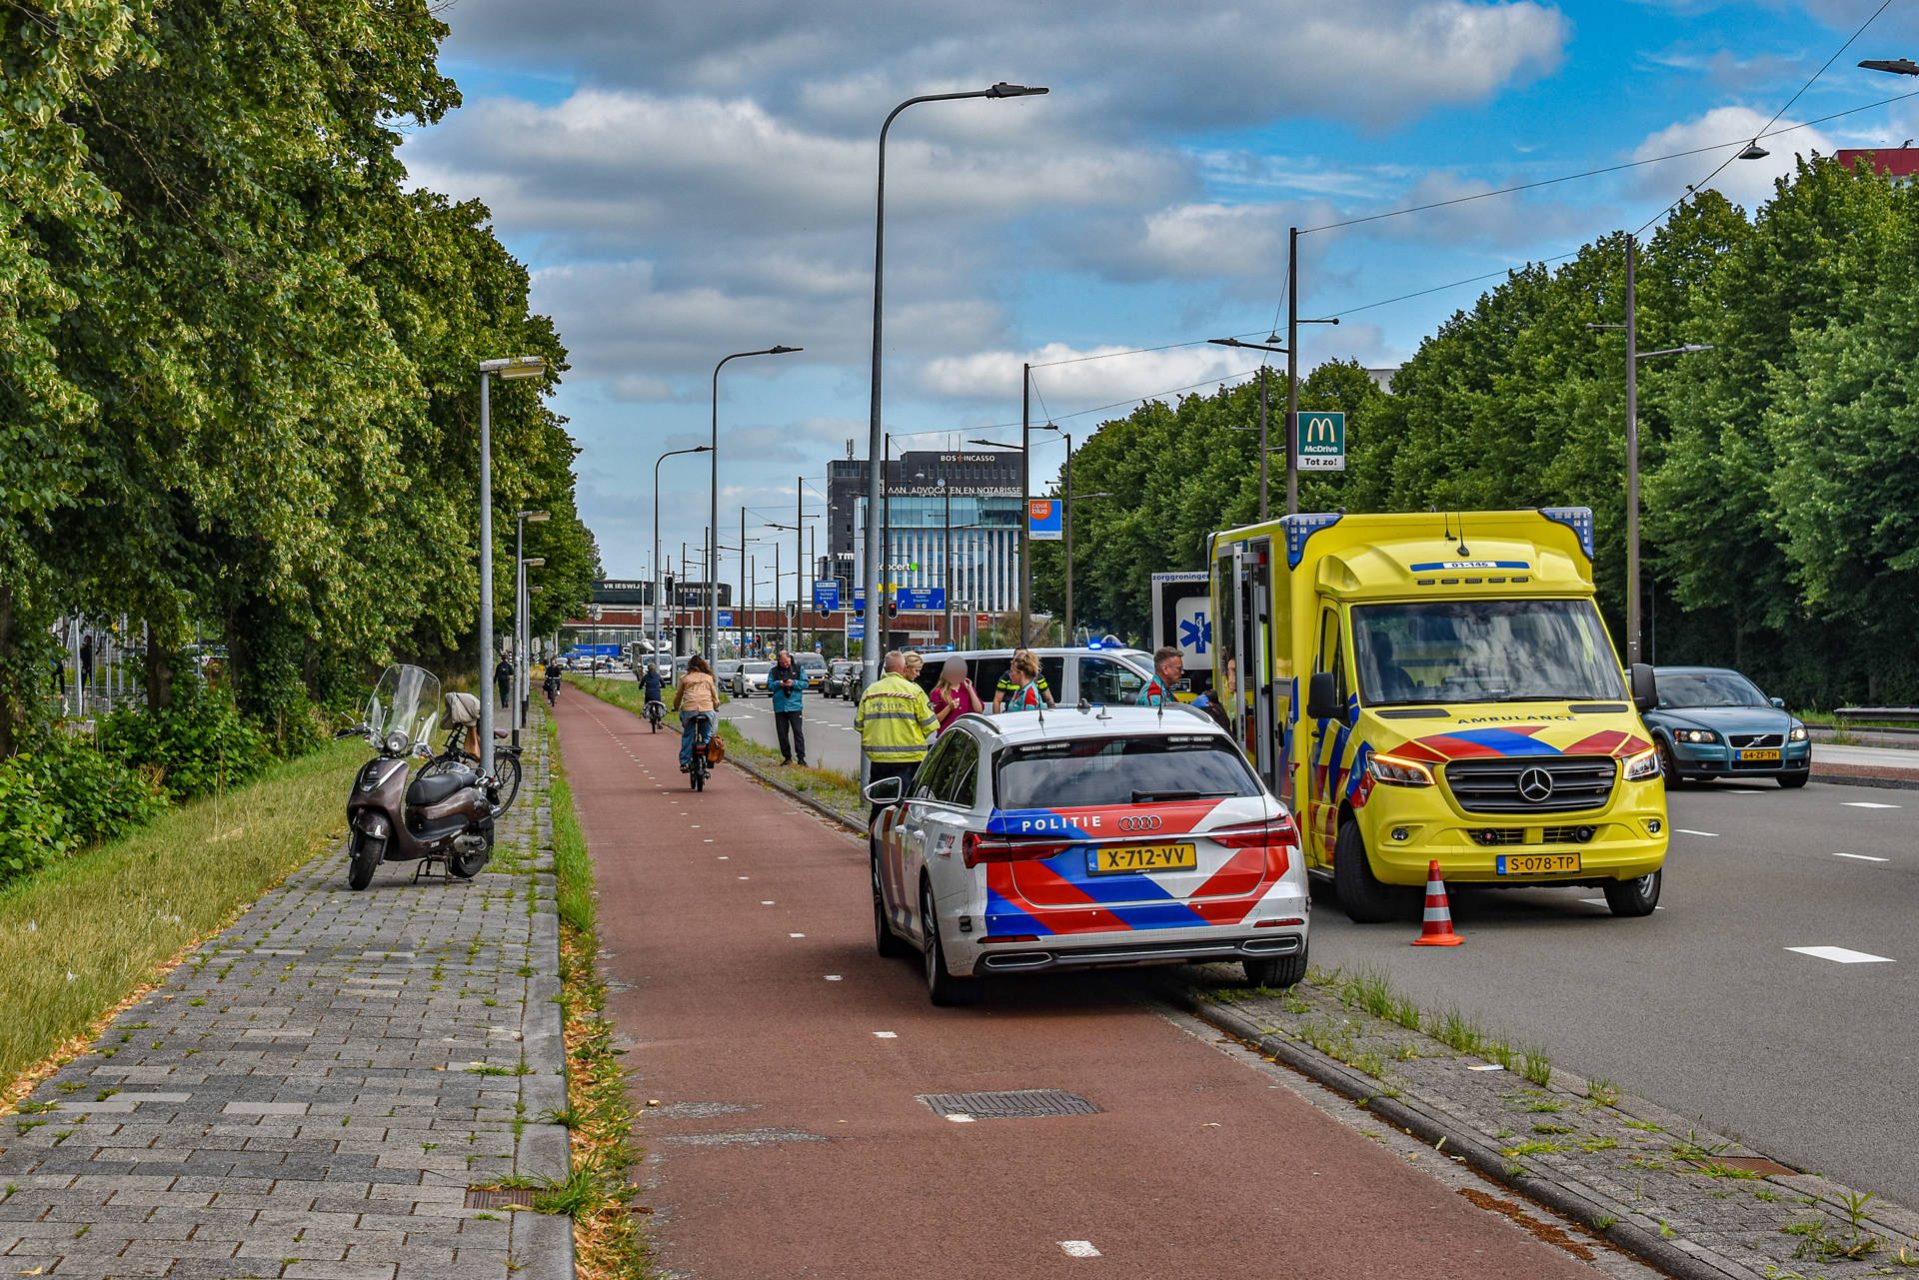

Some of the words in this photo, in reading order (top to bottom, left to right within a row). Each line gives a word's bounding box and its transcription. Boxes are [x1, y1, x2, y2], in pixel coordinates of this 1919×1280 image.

[1304, 445, 1338, 453] McDrive
[1305, 458, 1320, 466] Tot
[1323, 458, 1338, 466] zo!
[911, 486, 962, 494] ADVOCAEN
[1458, 715, 1577, 724] AMBULANCE
[1021, 816, 1101, 832] POLITIE
[1108, 847, 1185, 868] X-712-VV
[1510, 856, 1575, 871] S-078-TP
